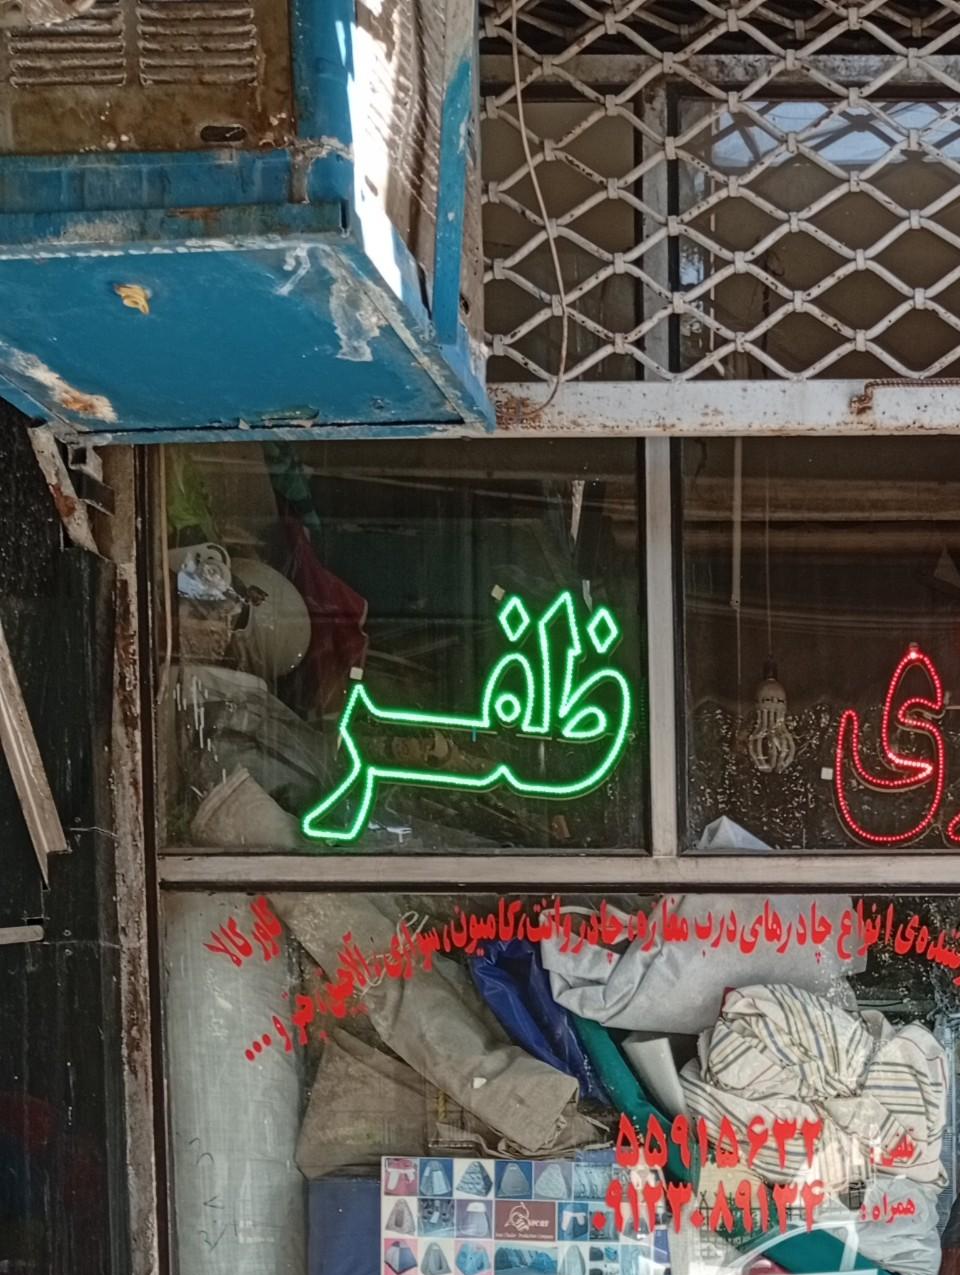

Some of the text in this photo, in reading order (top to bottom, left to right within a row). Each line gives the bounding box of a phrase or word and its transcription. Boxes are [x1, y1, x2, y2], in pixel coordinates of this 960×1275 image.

[302, 589, 632, 840] ظفر
[571, 898, 625, 965] چادر
[694, 909, 738, 957] درب
[836, 898, 894, 961] انواع
